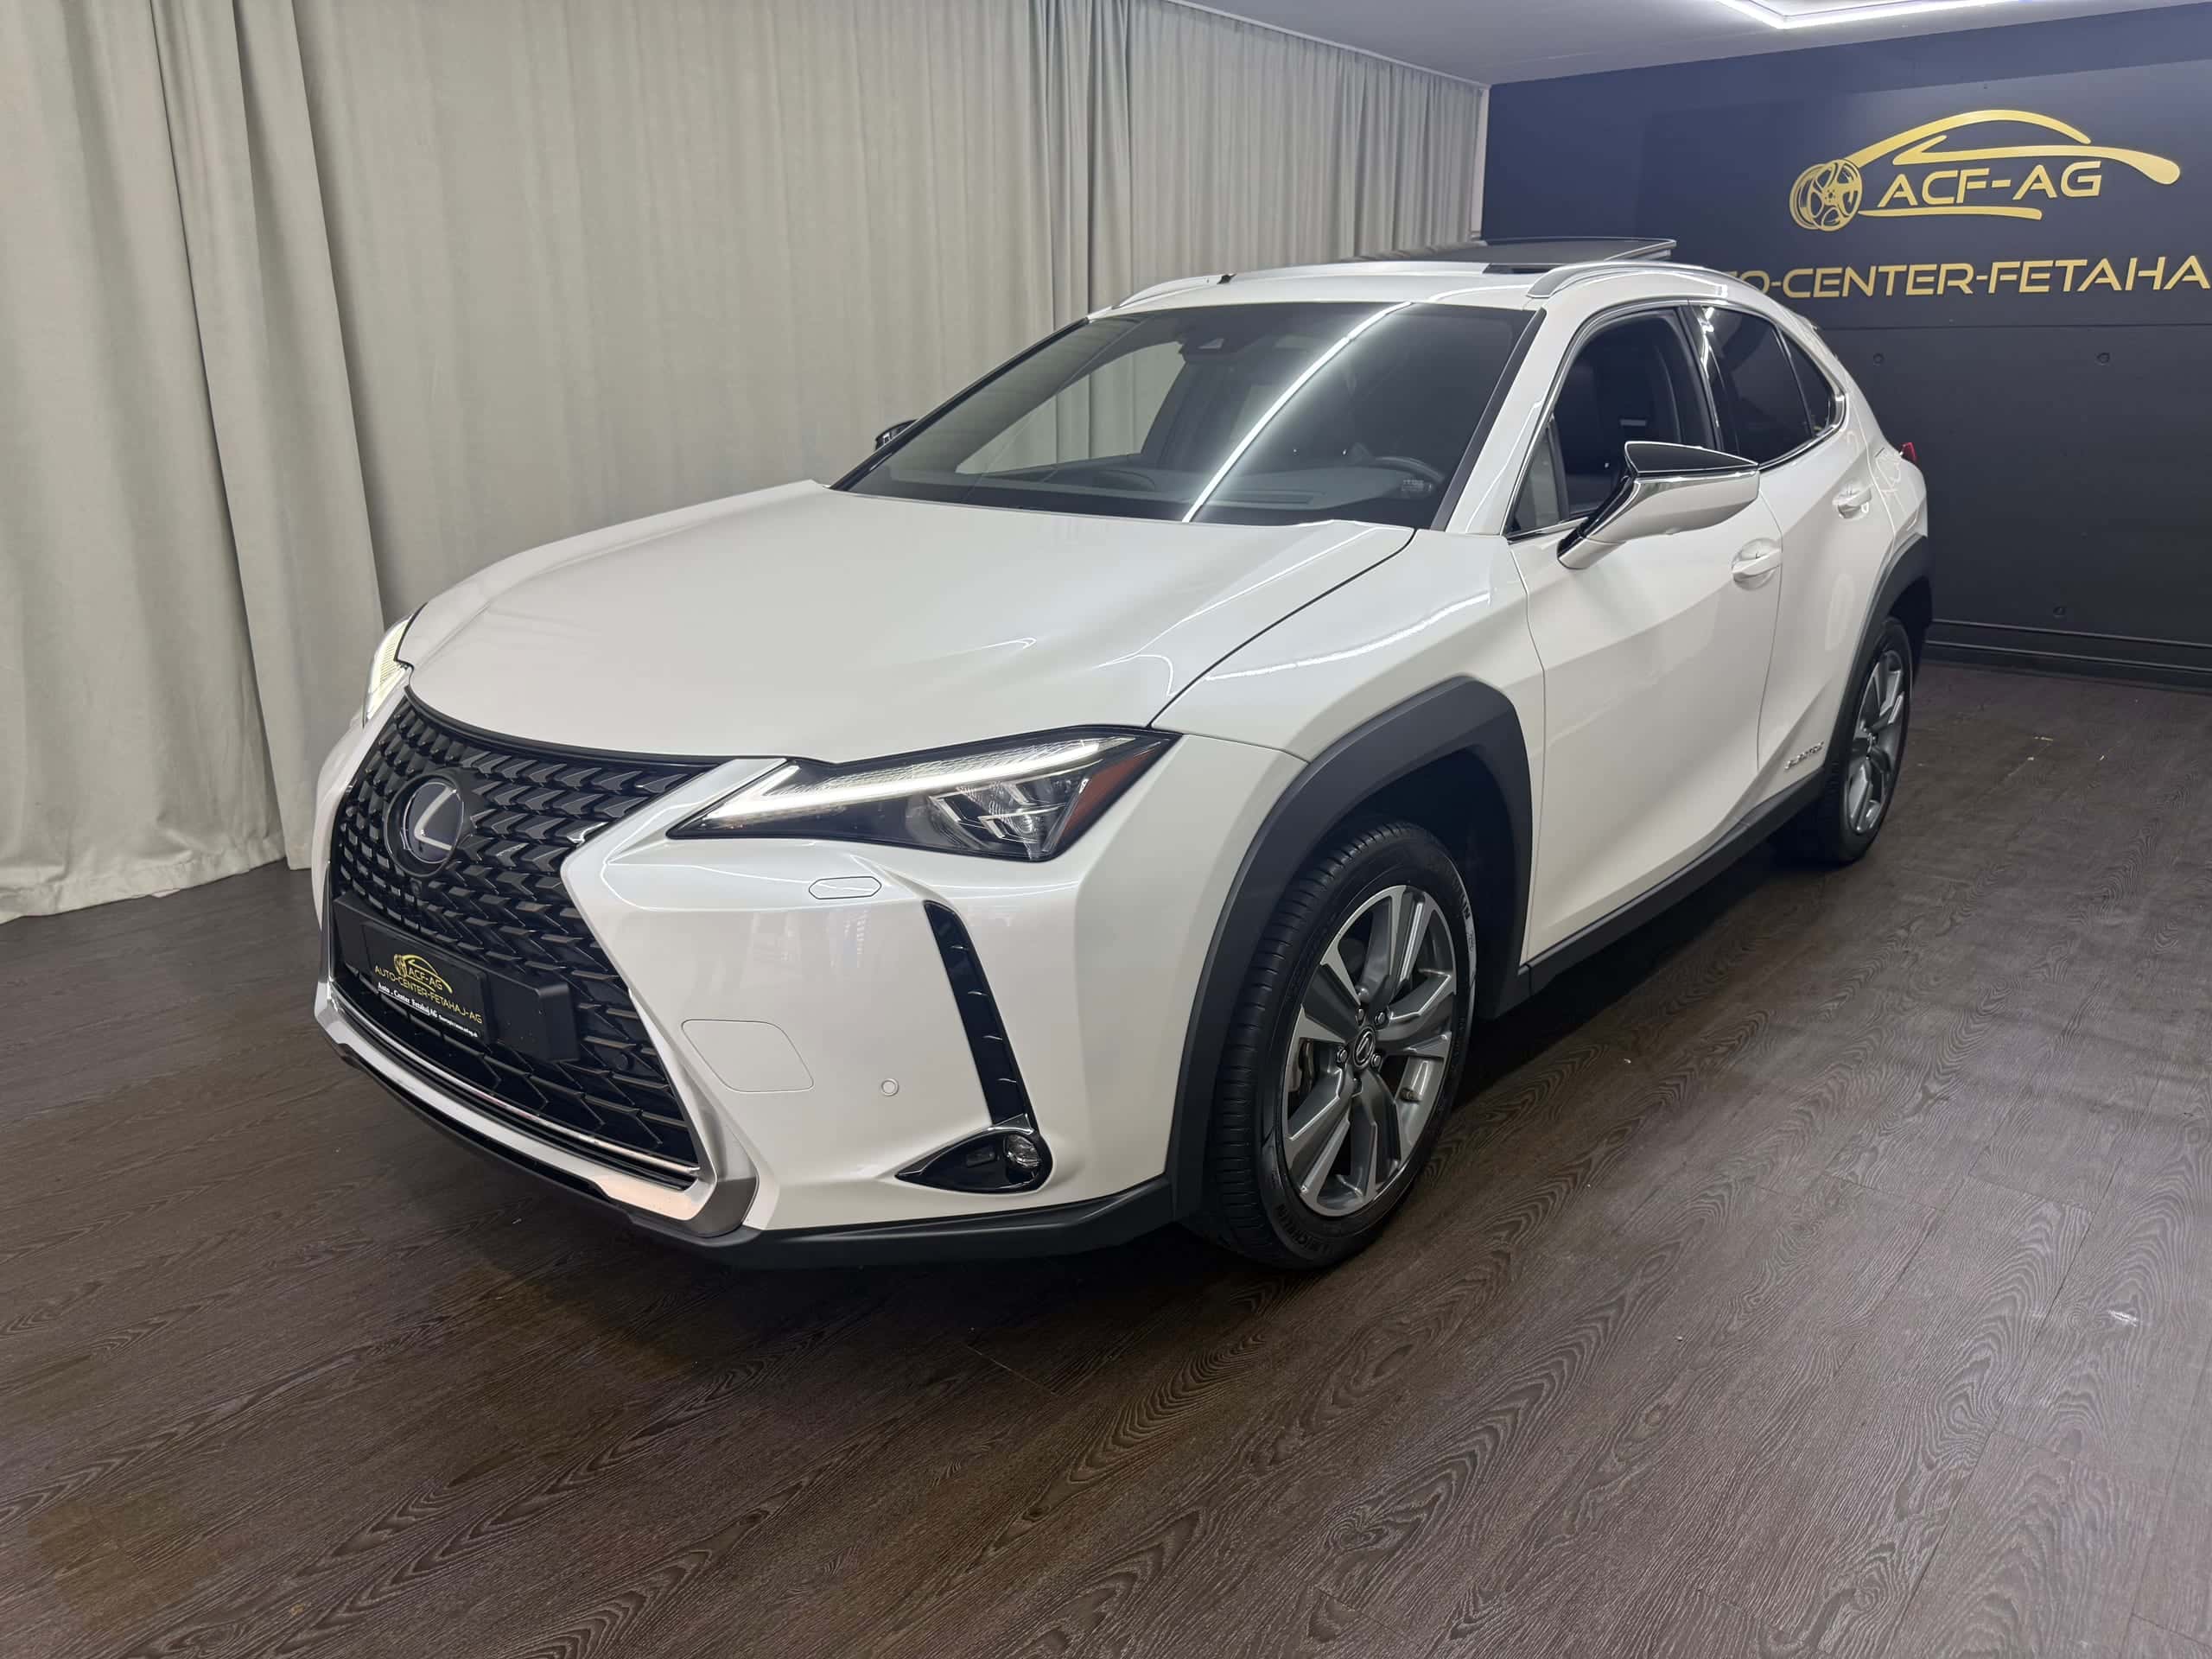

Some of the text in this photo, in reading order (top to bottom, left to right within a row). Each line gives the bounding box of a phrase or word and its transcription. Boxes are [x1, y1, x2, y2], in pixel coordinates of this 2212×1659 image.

[1877, 161, 2102, 207] ACF-AG
[1726, 255, 2211, 297] O-CENTER-FETAHA
[375, 965, 482, 1024] AUTO-CENTER-FETAHAJ-AG
[409, 968, 442, 990] ACF-AG
